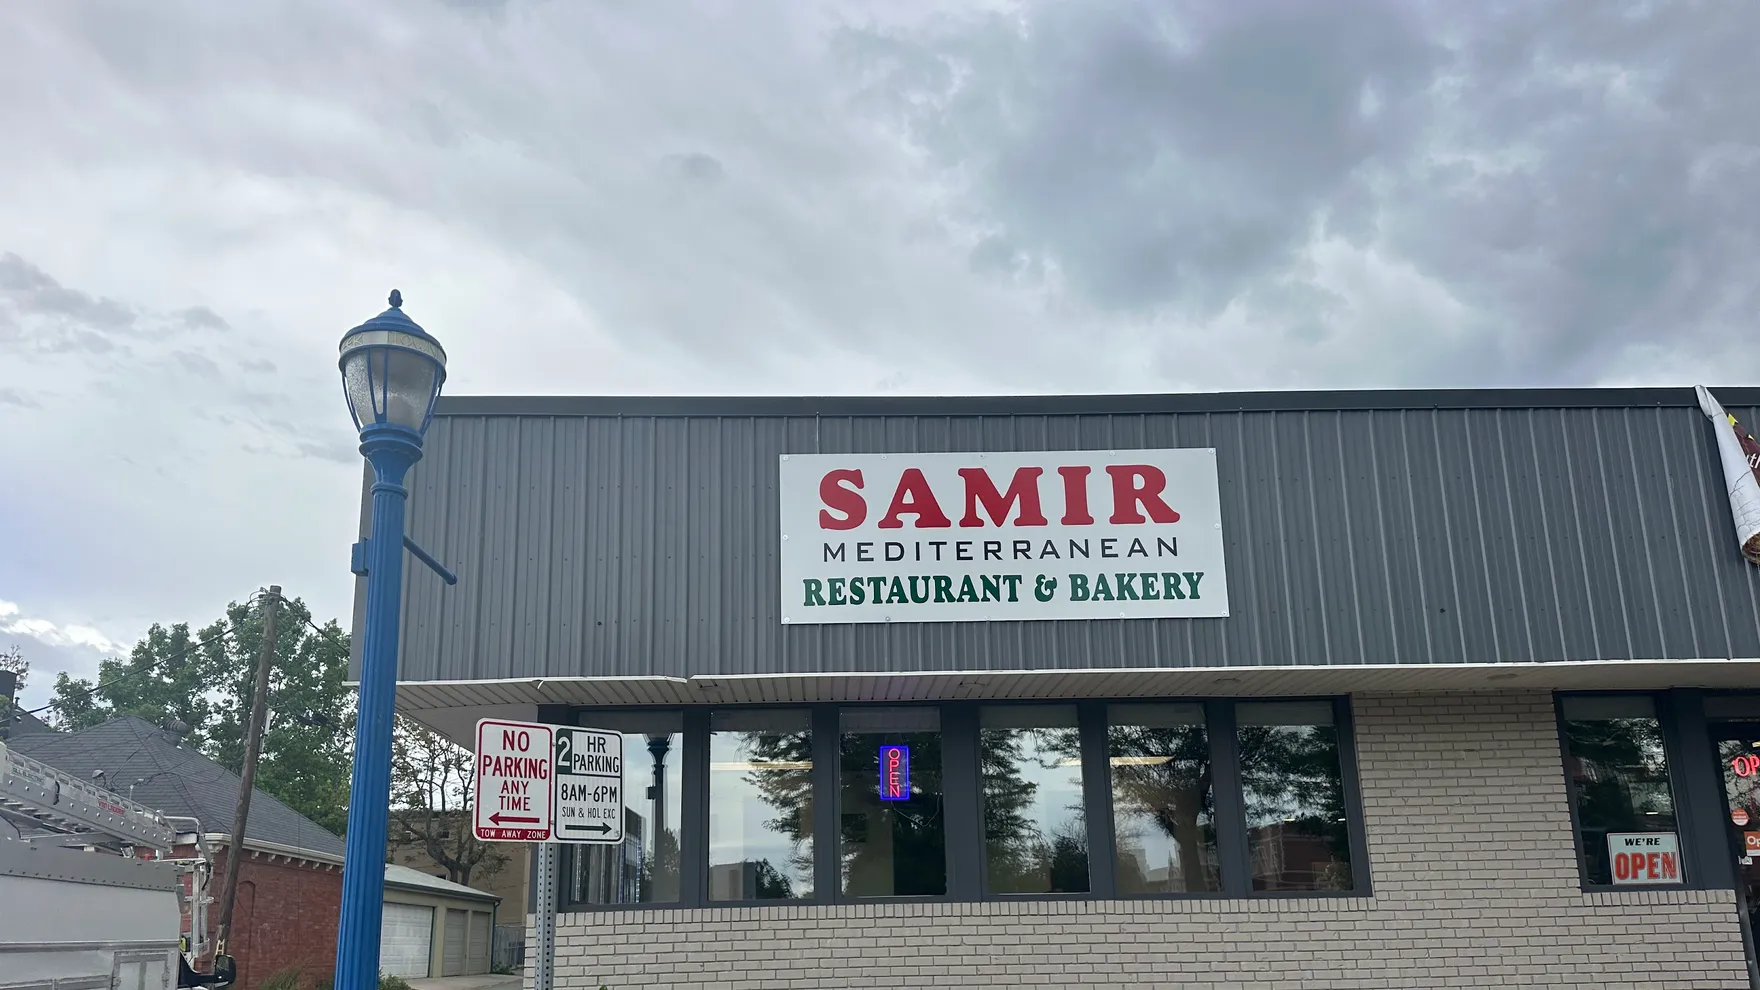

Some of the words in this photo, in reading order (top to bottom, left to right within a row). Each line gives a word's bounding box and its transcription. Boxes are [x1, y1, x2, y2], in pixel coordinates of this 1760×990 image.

[819, 464, 1181, 531] SAMIR
[823, 537, 1178, 563] MEDITERRANEAN
[803, 574, 1023, 607] RESTAURANT
[1034, 574, 1058, 602] &
[1069, 572, 1205, 602] BAKERY
[502, 729, 530, 752] NO
[557, 736, 571, 767] 2
[587, 735, 606, 754] HR
[482, 755, 548, 780] PARKING
[573, 753, 620, 774] PARKING
[888, 748, 900, 798] OPEN
[500, 780, 530, 795] ANY
[560, 783, 617, 803] 8AM-6PM
[499, 795, 531, 811] TIME
[562, 806, 576, 817] SUN
[578, 807, 585, 818] &
[588, 807, 601, 819] HOL
[603, 808, 616, 819] EXC
[480, 828, 496, 837] TOW
[501, 829, 521, 838] AWAY
[527, 830, 546, 839] ZONE
[1624, 837, 1660, 846] WE'RE
[1614, 851, 1677, 880] OPEN
